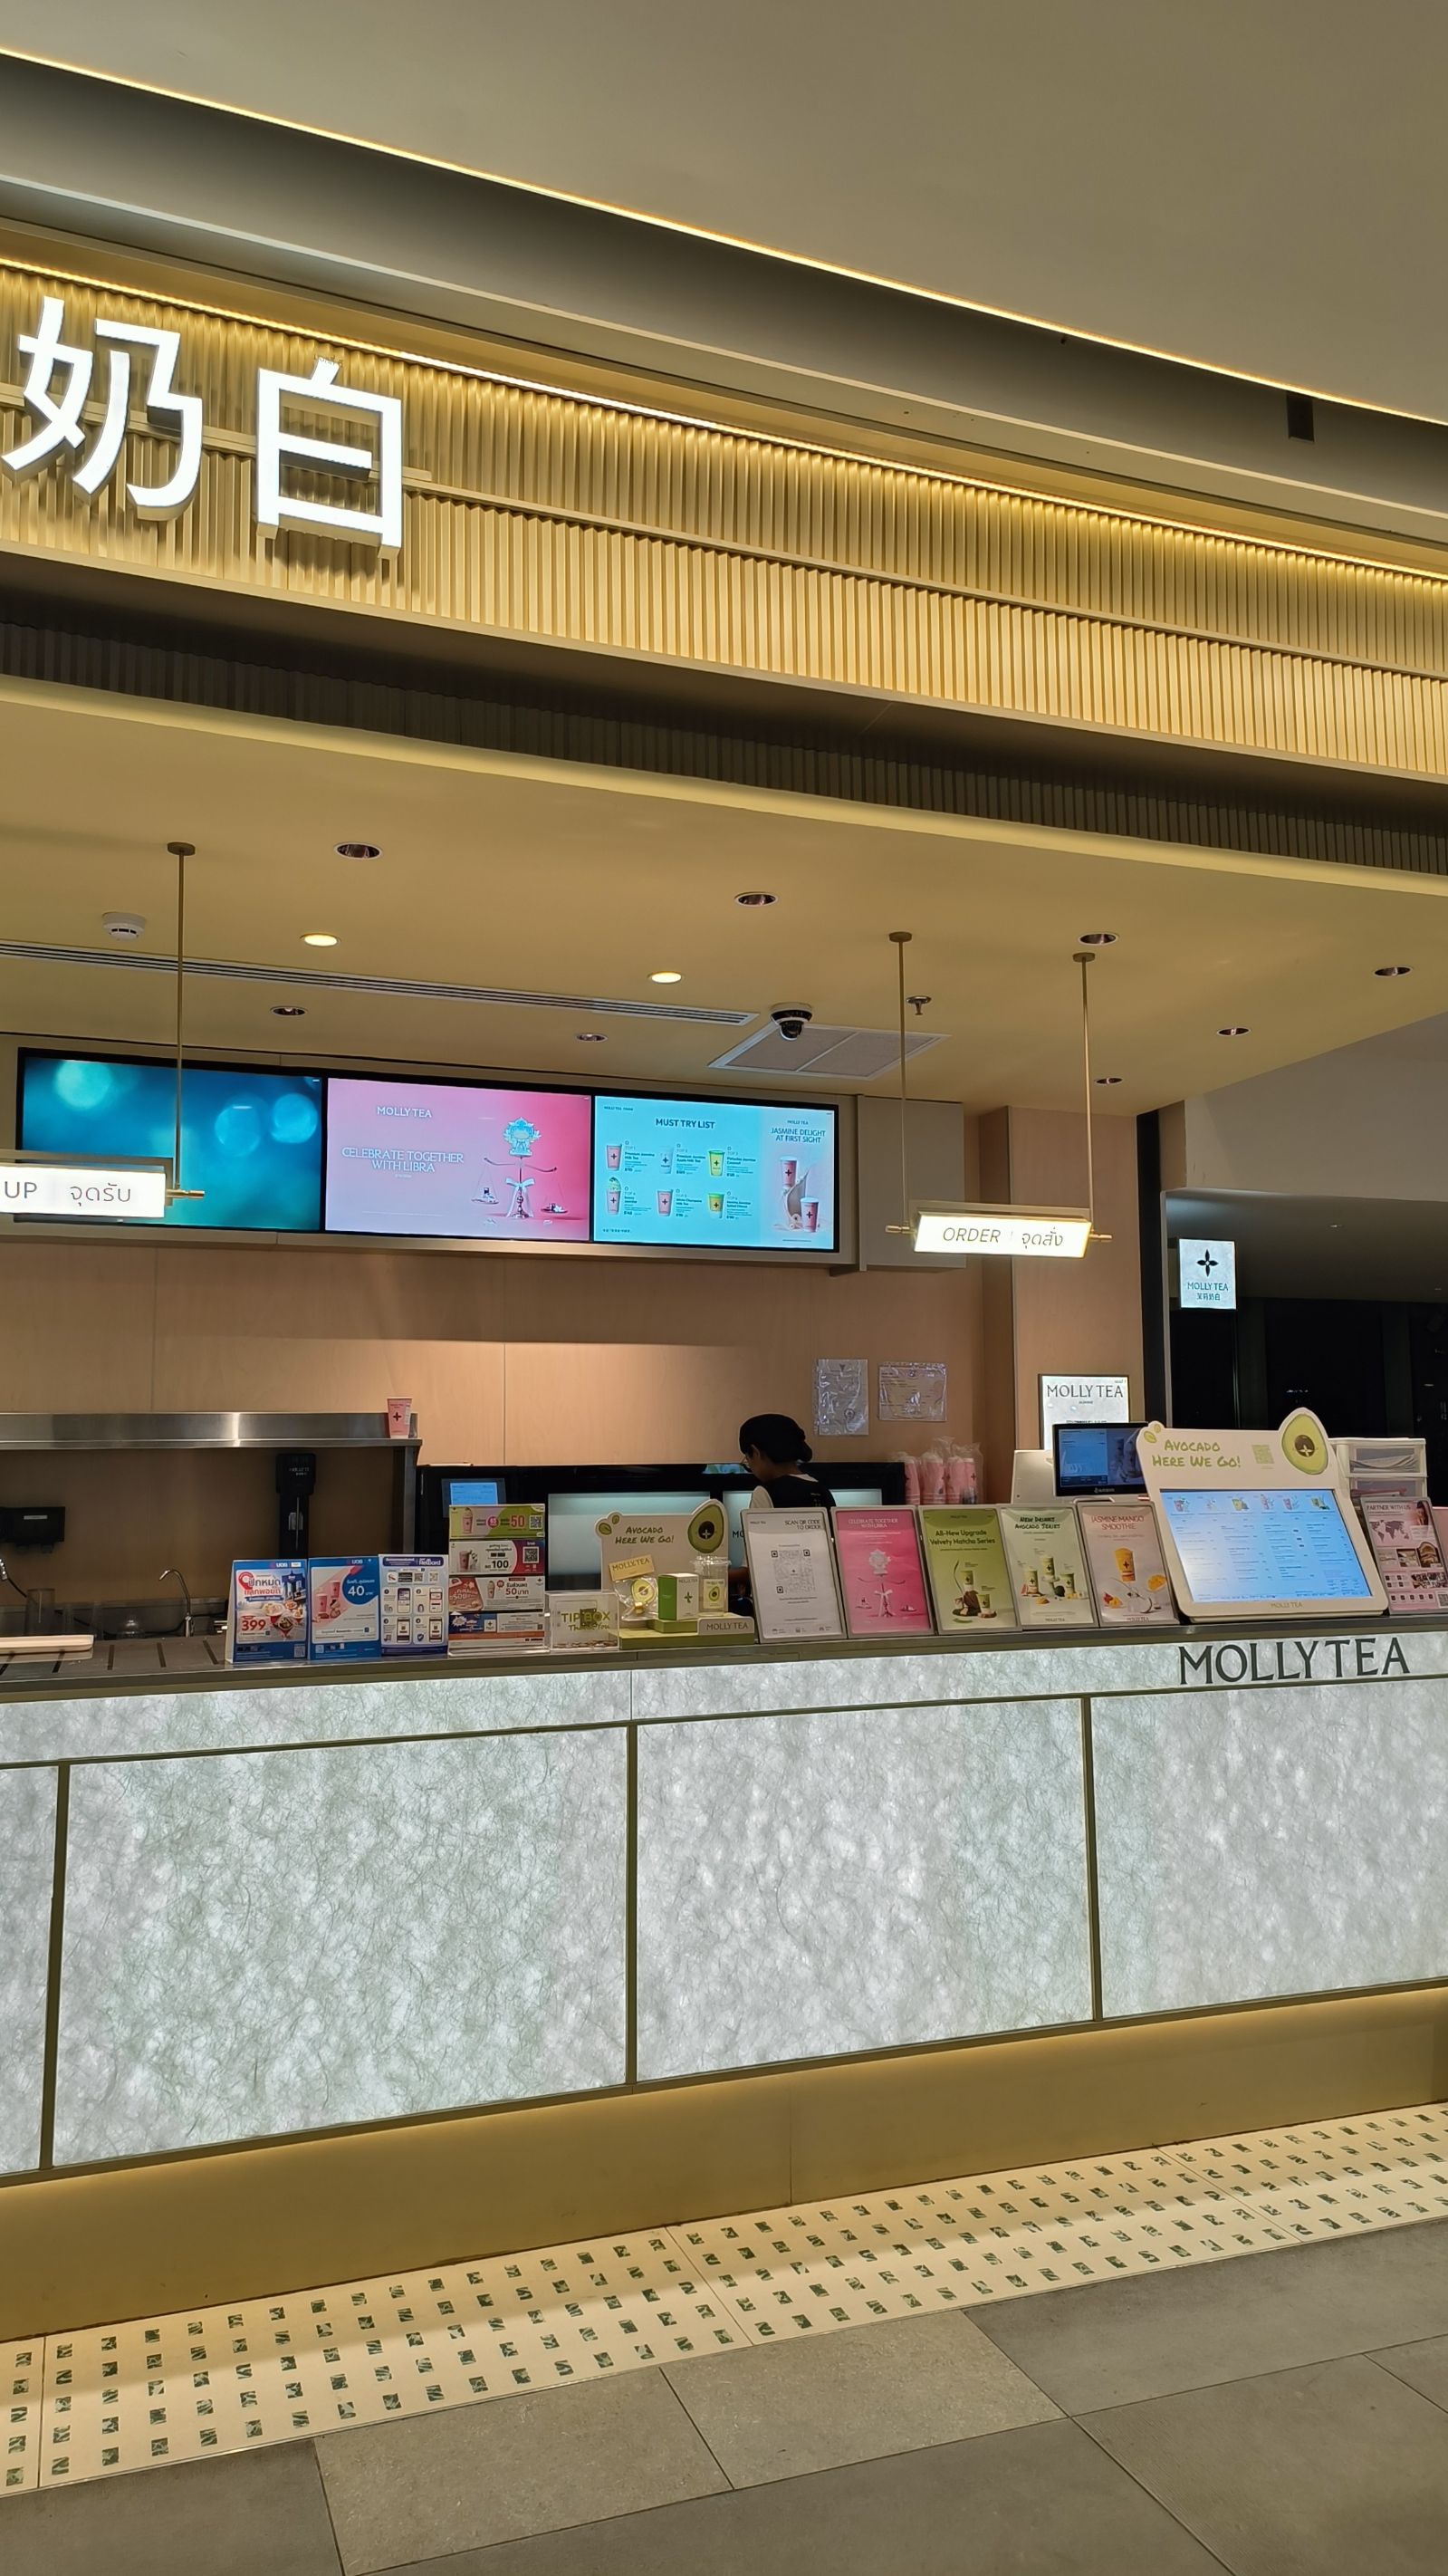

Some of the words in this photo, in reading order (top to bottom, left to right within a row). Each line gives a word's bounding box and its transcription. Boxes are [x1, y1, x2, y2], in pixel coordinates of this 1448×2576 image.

[3, 296, 402, 549] 奶白
[377, 1106, 411, 1117] MOLLY
[412, 1108, 432, 1119] TEA
[656, 1118, 679, 1127] MUST
[680, 1120, 696, 1128] TRY
[697, 1120, 715, 1129] LIST
[771, 1128, 799, 1136] JASMINE
[800, 1129, 826, 1137] DELIGHT
[802, 1136, 821, 1144] SIGHT
[341, 1147, 404, 1160] CELEBRATE
[407, 1150, 464, 1163] TOGETHER
[371, 1159, 401, 1171] WITH
[403, 1161, 435, 1172] LIBRA
[5, 1181, 38, 1198] UP
[70, 1182, 131, 1206] จุดรับ
[943, 1227, 1001, 1243] ORDER
[1021, 1226, 1064, 1249] จุดสั่ง
[1187, 1282, 1213, 1291] MOLLY
[1213, 1283, 1229, 1292] TEA
[1047, 1384, 1093, 1398] MOLLY
[1096, 1384, 1124, 1398] TEA
[1165, 1439, 1221, 1452] AVOCADO
[1151, 1455, 1185, 1467] HERE
[1189, 1455, 1213, 1467] WE
[1216, 1456, 1241, 1468] GO!
[511, 1514, 525, 1528] 50
[1118, 1514, 1145, 1523] MANGO
[625, 1525, 664, 1534] AVOCADO
[1101, 1523, 1136, 1531] SMOOTHIE
[615, 1536, 638, 1544] HERE
[639, 1535, 655, 1543] WE
[657, 1535, 675, 1543] GO!
[492, 1560, 509, 1569] 100
[612, 1560, 636, 1572] MOLLY
[636, 1557, 650, 1565] TEA
[348, 1585, 365, 1596] 40
[561, 1612, 580, 1622] TIP
[584, 1611, 610, 1621] BOX
[241, 1619, 266, 1631] 399
